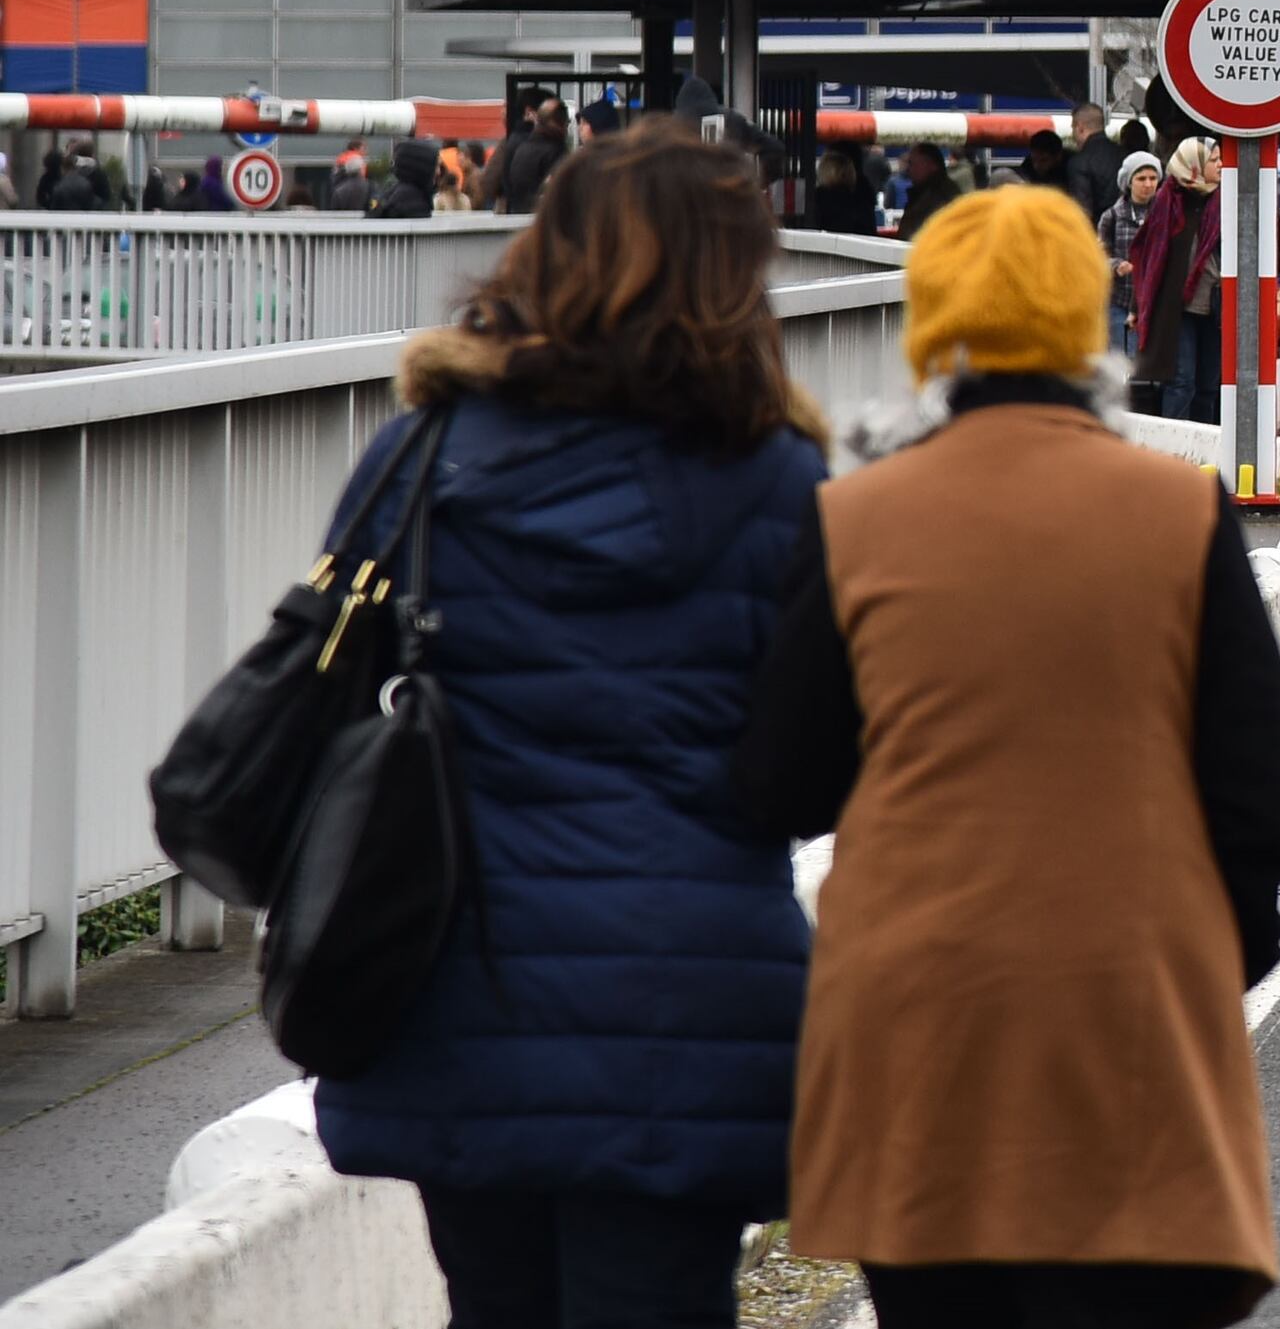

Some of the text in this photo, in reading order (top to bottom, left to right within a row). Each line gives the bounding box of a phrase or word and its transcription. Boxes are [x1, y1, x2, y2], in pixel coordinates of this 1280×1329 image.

[1207, 7, 1241, 22] LPG
[1222, 45, 1277, 62] VALUE
[245, 169, 269, 190] 10
